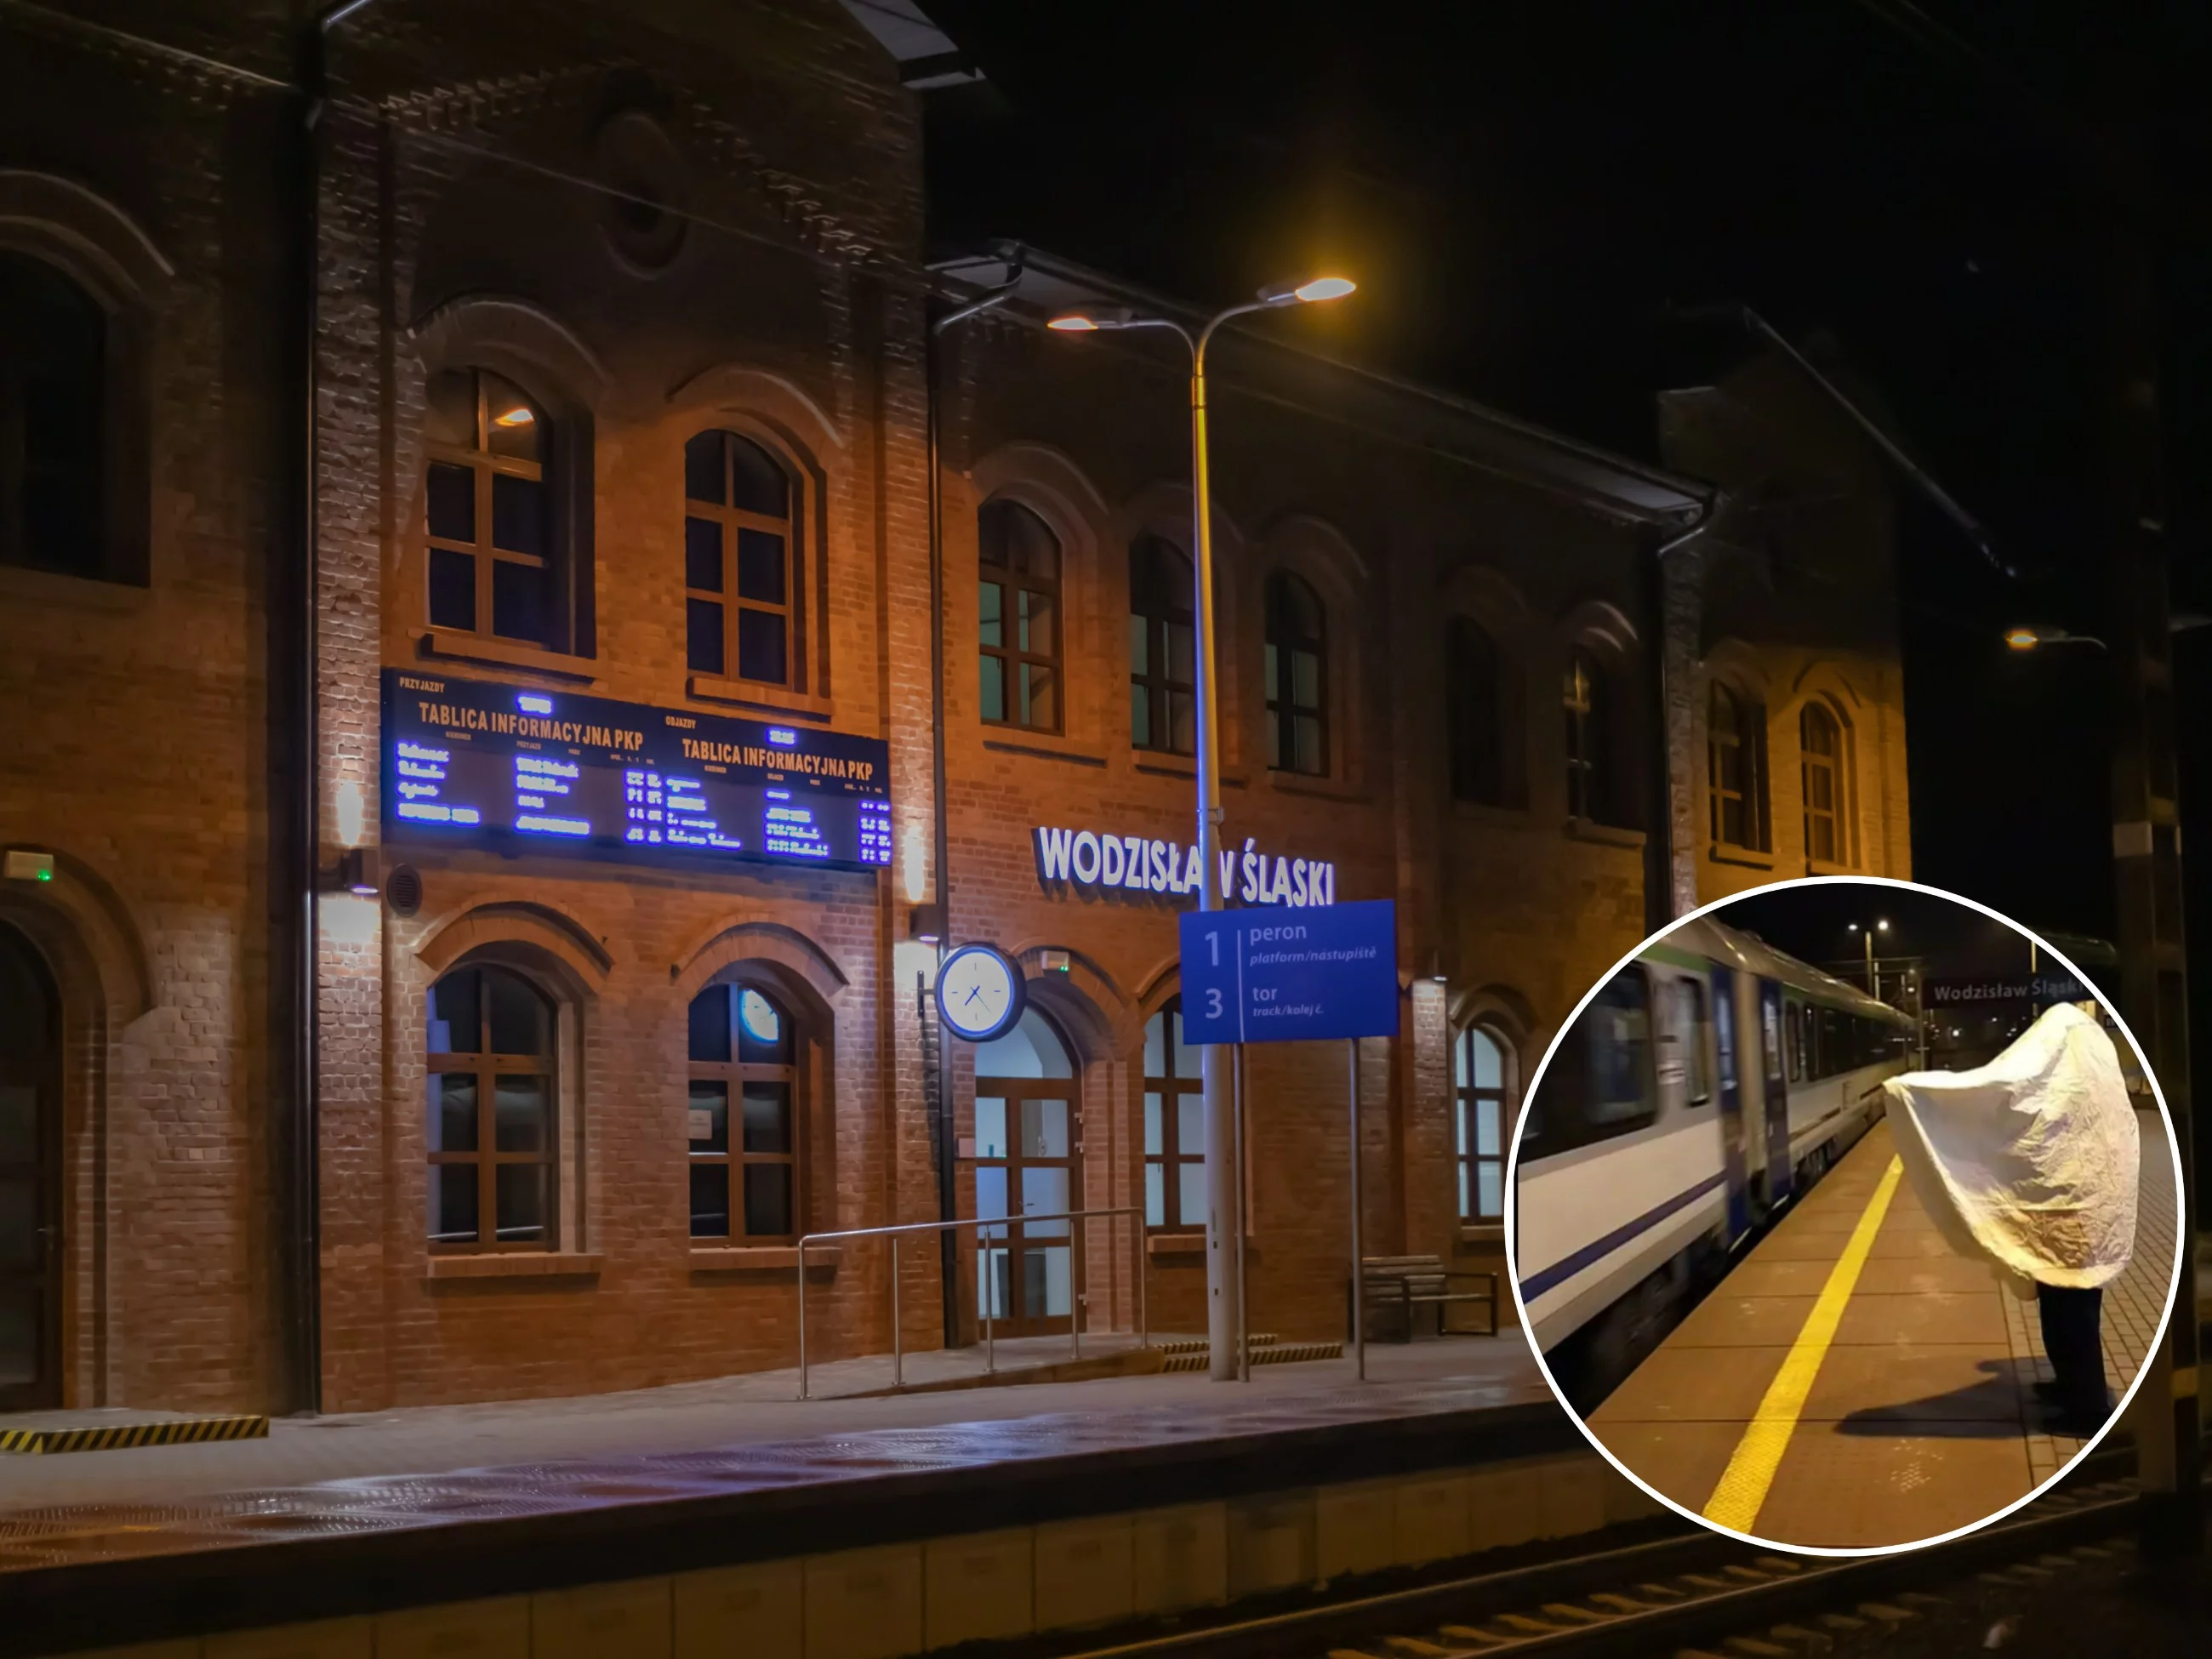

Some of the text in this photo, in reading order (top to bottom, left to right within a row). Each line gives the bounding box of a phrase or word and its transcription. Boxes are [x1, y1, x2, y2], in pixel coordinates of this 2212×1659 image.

[400, 677, 445, 693] PRZYJAZDY
[419, 702, 488, 731] TABLICA
[492, 712, 612, 748] INFORMACYJNA
[614, 729, 643, 751] PKP
[665, 715, 696, 729] ODJAZDY
[682, 738, 741, 764] TABLICA
[744, 746, 847, 778] INFORMACYJNA
[847, 760, 873, 781] PKP
[1242, 837, 1333, 908] ŚLĄSKI
[1205, 931, 1219, 966] 1
[1250, 925, 1307, 946] peron
[1205, 988, 1223, 1019] 3
[1252, 987, 1278, 1001] tor
[1934, 981, 2028, 1001] Wodzisław
